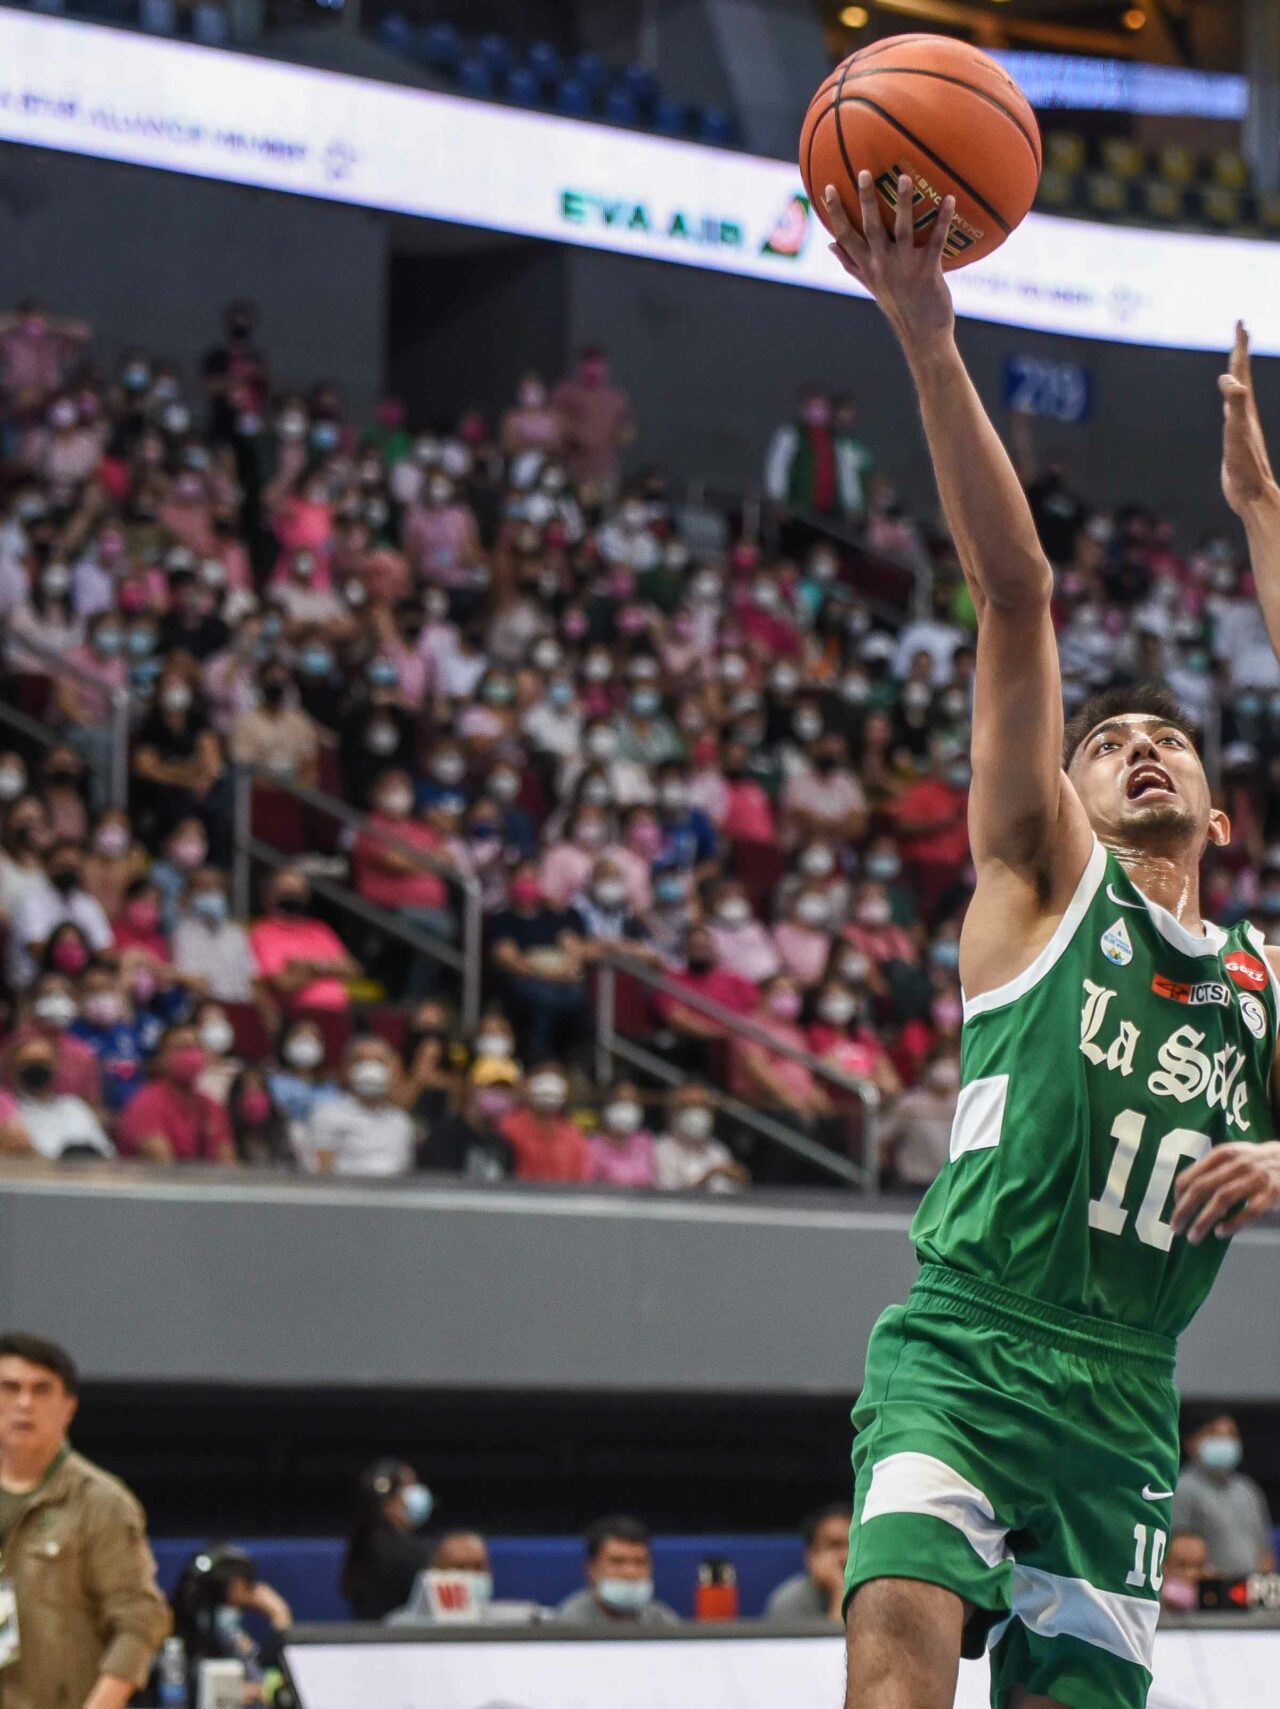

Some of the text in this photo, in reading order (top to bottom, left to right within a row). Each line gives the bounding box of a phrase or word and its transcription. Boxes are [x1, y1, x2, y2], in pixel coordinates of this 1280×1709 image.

[560, 190, 650, 231] EVA
[1079, 978, 1141, 1077] La
[1190, 983, 1229, 1004] ICTSI
[1088, 1108, 1213, 1252] 10
[1125, 1523, 1167, 1592] 10
